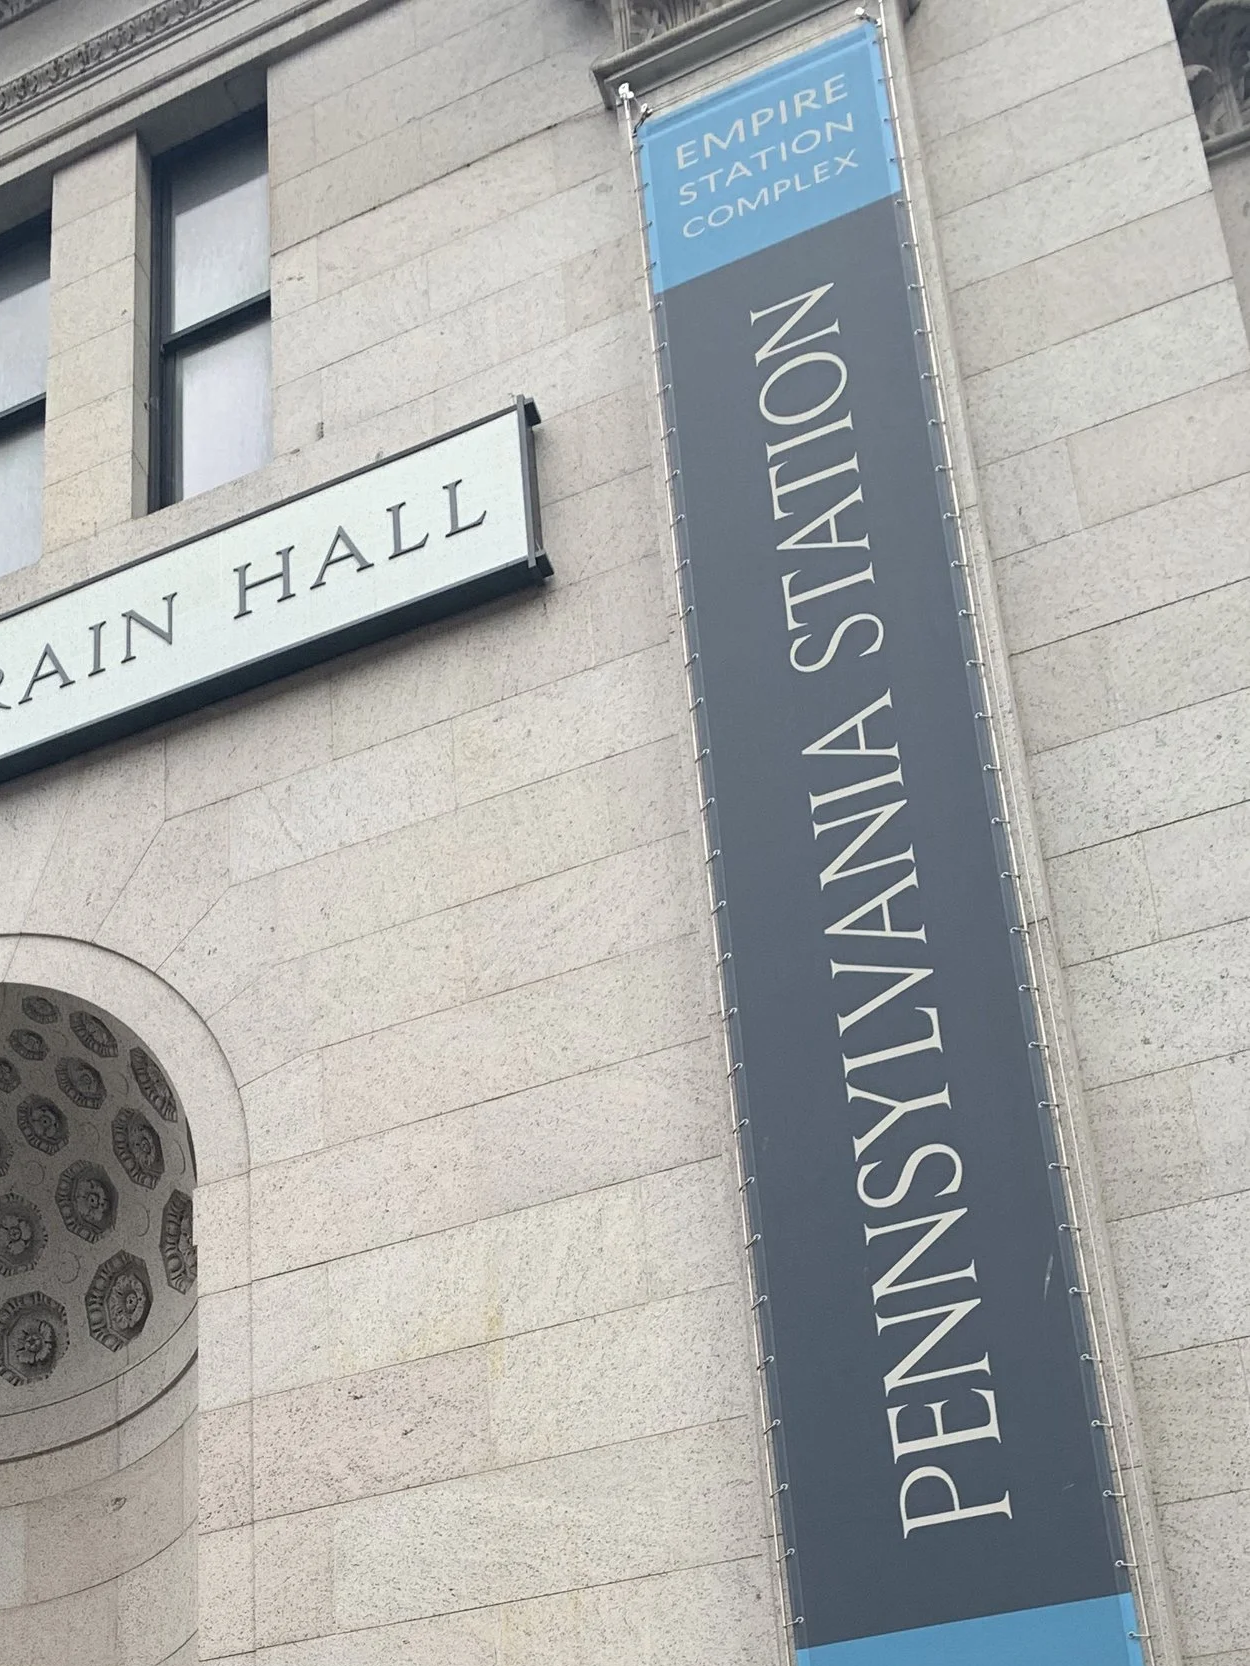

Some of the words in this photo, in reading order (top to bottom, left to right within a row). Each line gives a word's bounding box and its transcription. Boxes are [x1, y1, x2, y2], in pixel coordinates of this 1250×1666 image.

[676, 73, 849, 170] EMPIRE
[679, 112, 854, 205] STATION
[682, 149, 859, 238] COMPLEX
[750, 282, 885, 673] STATION
[233, 478, 487, 620] HALL
[802, 687, 1013, 1539] PENNSYLVANIA
